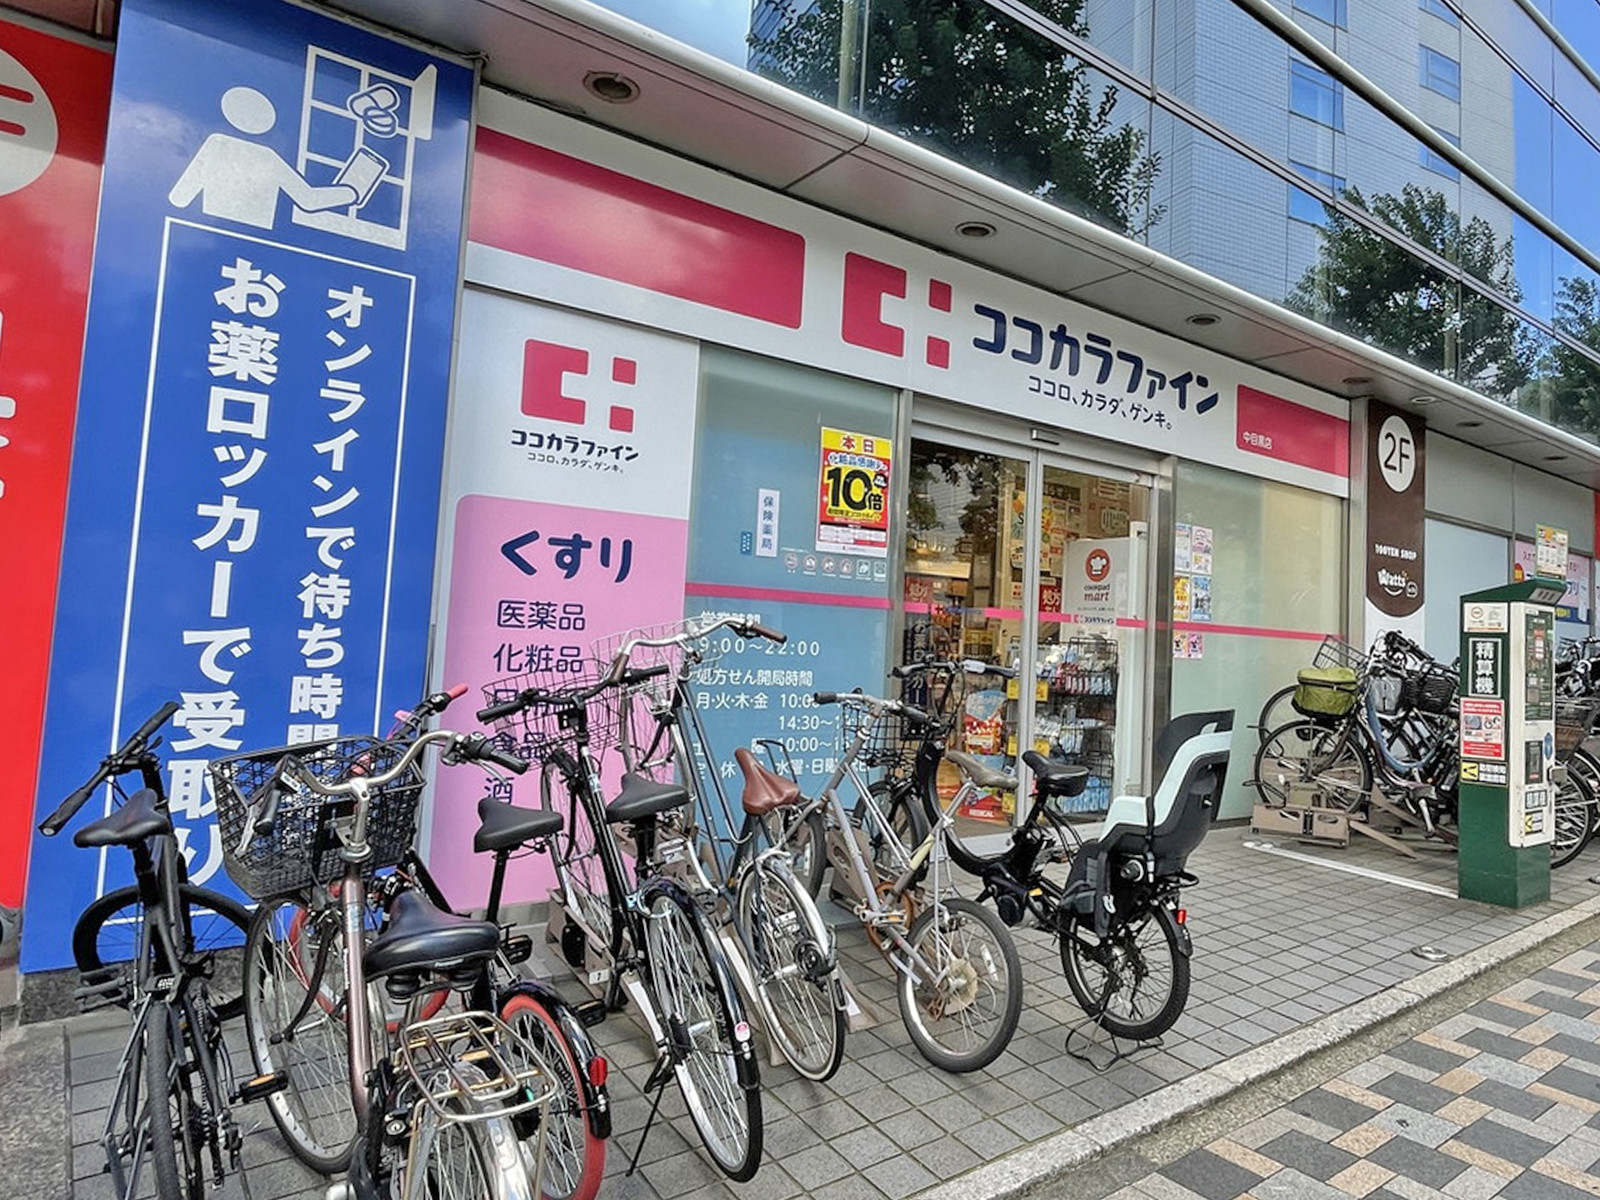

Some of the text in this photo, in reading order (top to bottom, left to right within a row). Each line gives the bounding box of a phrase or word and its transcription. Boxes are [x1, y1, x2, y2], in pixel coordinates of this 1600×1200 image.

[972, 303, 1220, 415] ココカラファイン
[1027, 374, 1174, 431] ココロ、カラダ、ゲンキ。
[511, 429, 639, 462] ココカラファイン
[1384, 431, 1411, 474] 2F
[169, 257, 286, 886] お薬ロッカーで受取り
[500, 530, 633, 583] くすり
[1083, 591, 1110, 602] mart
[1377, 568, 1406, 588] Watts
[497, 600, 586, 631] 医薬品
[493, 643, 584, 673] 化粧品
[1475, 641, 1495, 694] 精算機
[484, 777, 514, 803] 酒
